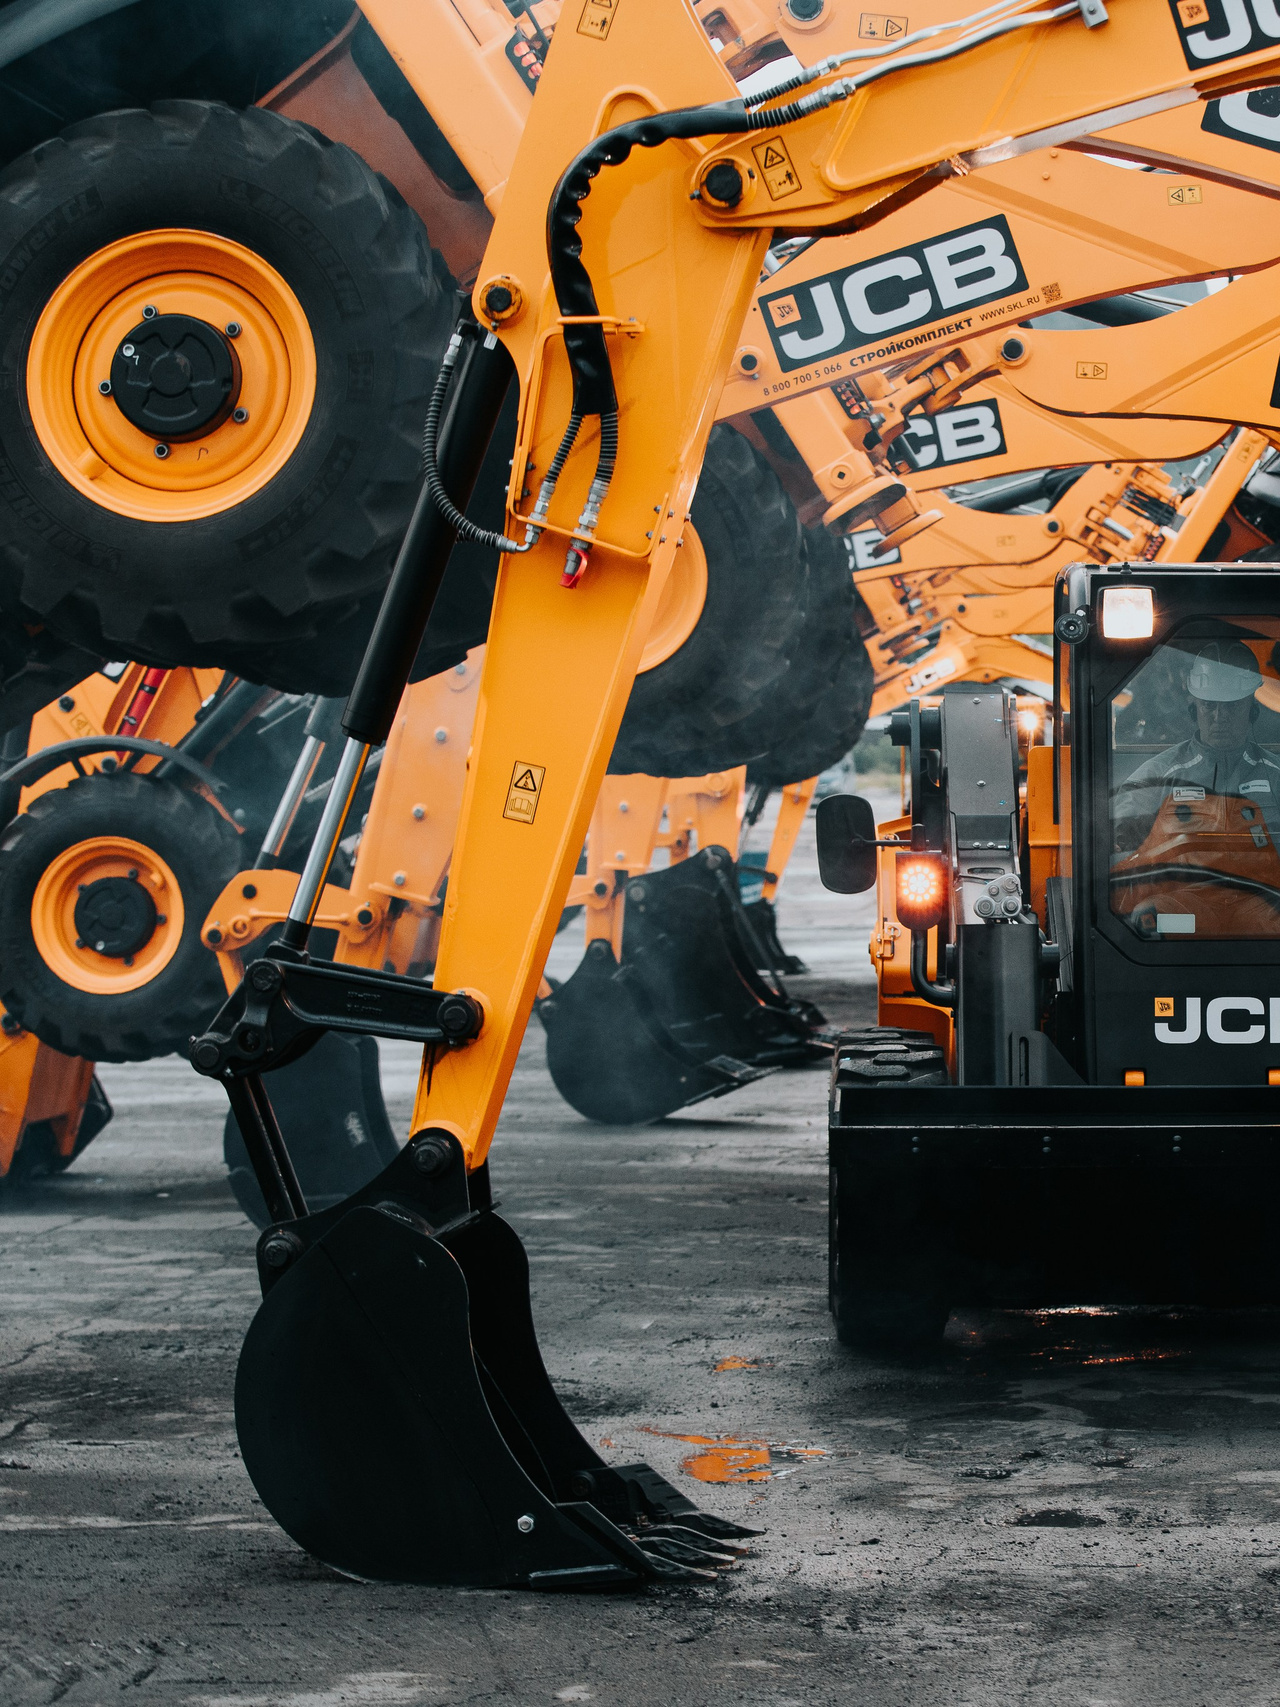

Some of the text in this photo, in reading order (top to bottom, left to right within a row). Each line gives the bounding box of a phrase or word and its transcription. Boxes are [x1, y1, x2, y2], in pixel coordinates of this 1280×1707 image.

[777, 304, 794, 319] JCB
[778, 228, 1018, 360] JCB
[763, 295, 1040, 396] 8 800 700 5 066 СТРОЙКОМПЛЕКТ WWW.SKL.RU
[903, 405, 1001, 468] CB
[906, 658, 956, 693] JCB
[1159, 1001, 1171, 1012] JCB
